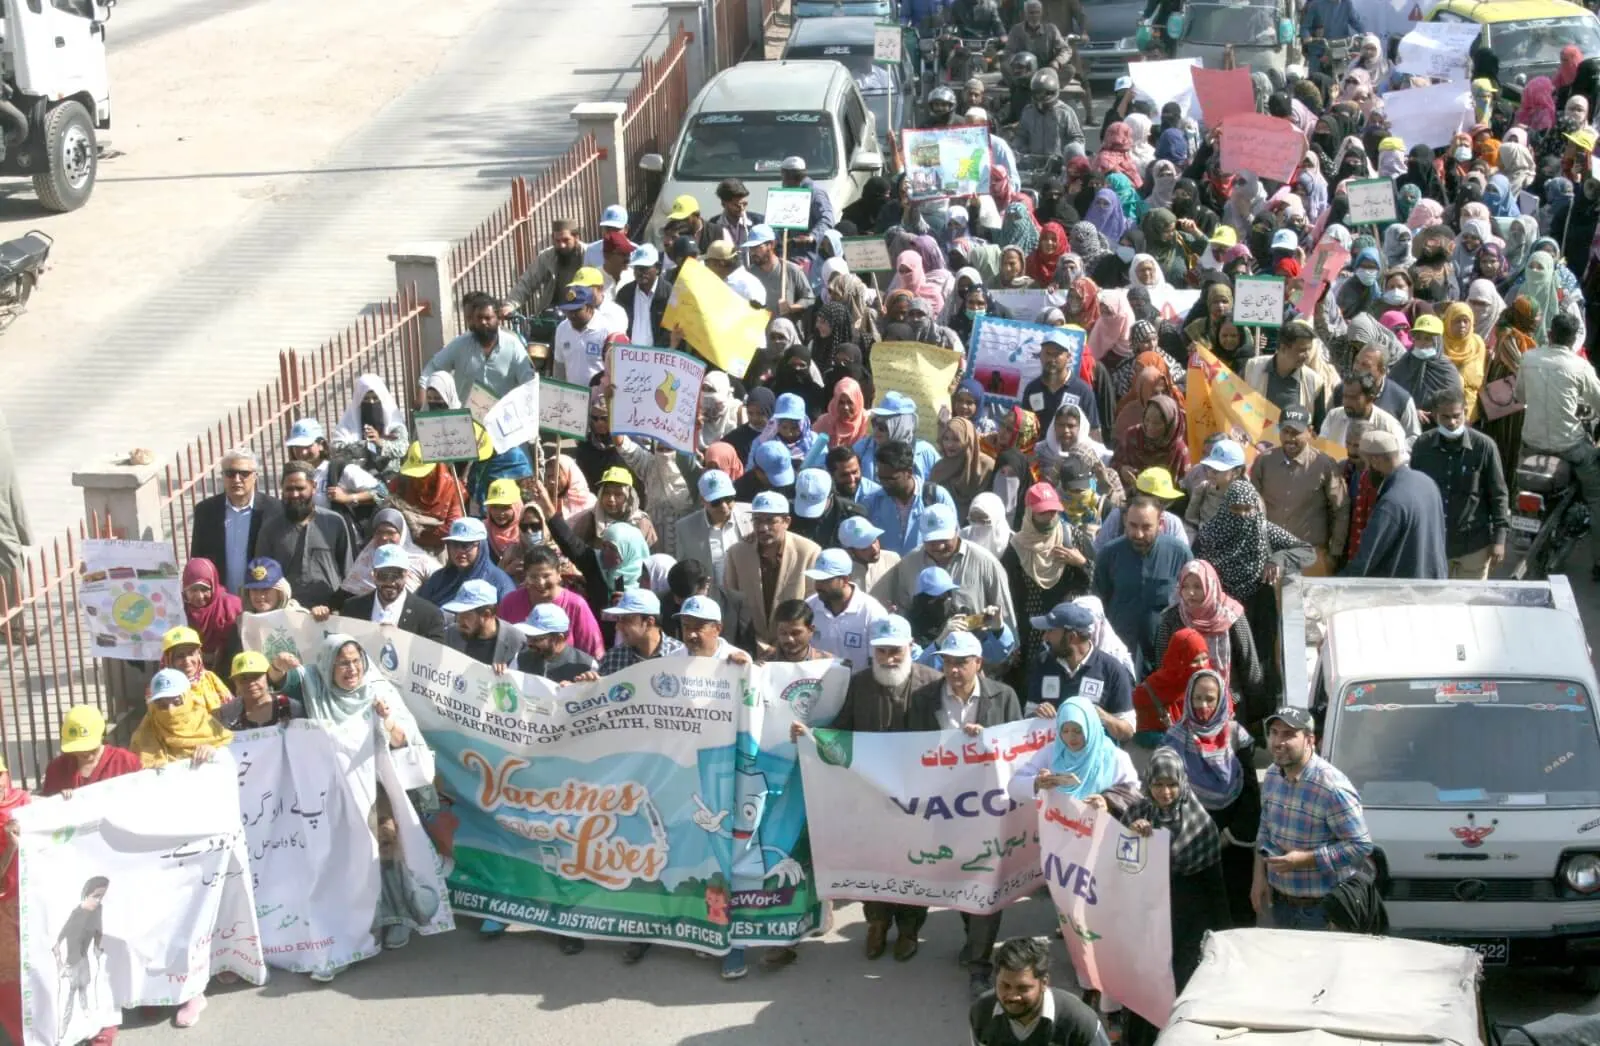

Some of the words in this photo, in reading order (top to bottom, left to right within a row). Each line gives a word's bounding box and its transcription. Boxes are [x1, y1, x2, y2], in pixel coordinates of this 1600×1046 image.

[654, 352, 676, 367] FREE
[412, 662, 452, 688] unicef
[681, 677, 703, 688] World
[706, 677, 730, 690] Health
[411, 682, 481, 718] EXPANDED
[485, 712, 566, 734] PROGRAM
[572, 714, 599, 728] ON
[606, 704, 732, 722] IMMUNIZATION
[565, 692, 608, 714] Gavi
[681, 688, 731, 700] Organization
[436, 706, 532, 745] DEPARTMENT
[538, 734, 563, 744] OF
[654, 718, 703, 734] SINDH
[463, 751, 644, 812] Vaccines
[556, 815, 663, 885] Lives
[454, 891, 488, 909] WEST
[488, 898, 549, 922] KARACHI
[558, 912, 615, 931] DISTRICT
[618, 919, 672, 936] HEALTH
[675, 923, 724, 946] OFFICER
